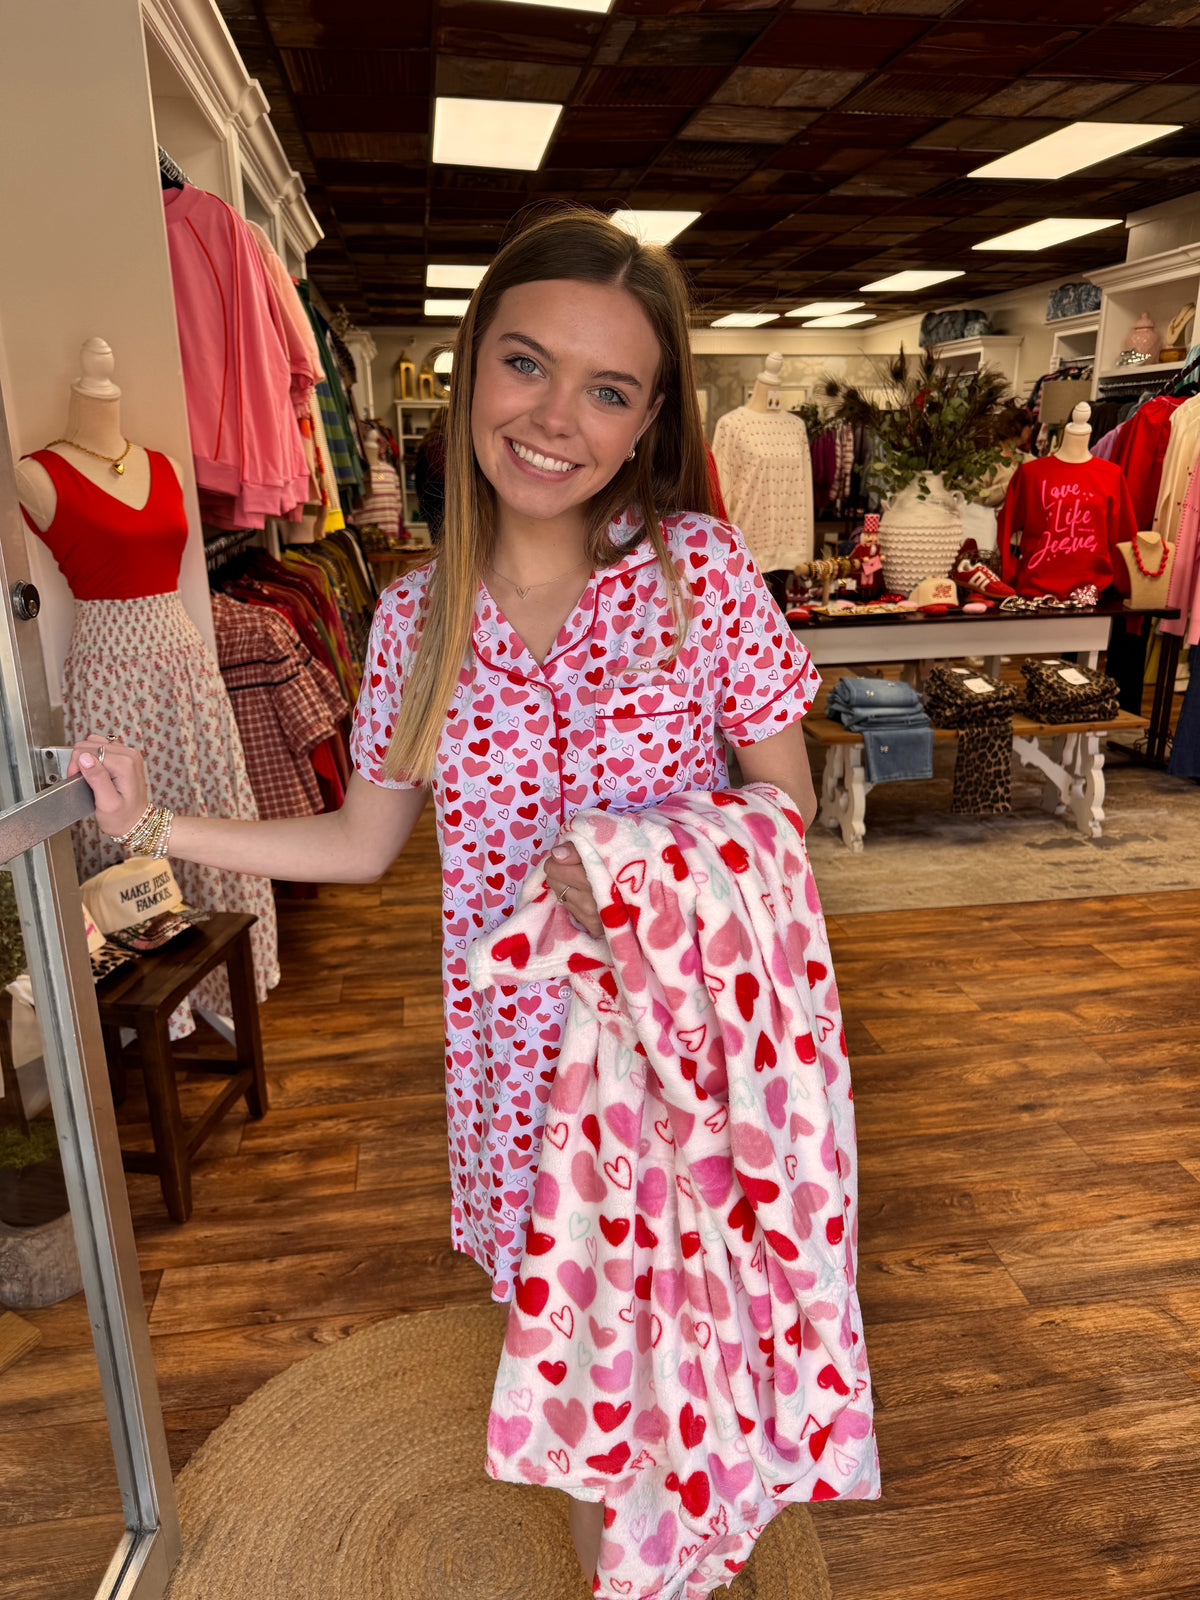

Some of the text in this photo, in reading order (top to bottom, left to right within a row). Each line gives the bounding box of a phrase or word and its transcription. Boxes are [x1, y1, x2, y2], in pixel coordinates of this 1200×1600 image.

[1055, 499, 1091, 537] Like
[1027, 531, 1098, 569] Jesus
[120, 871, 171, 903] MAKE JESUS
